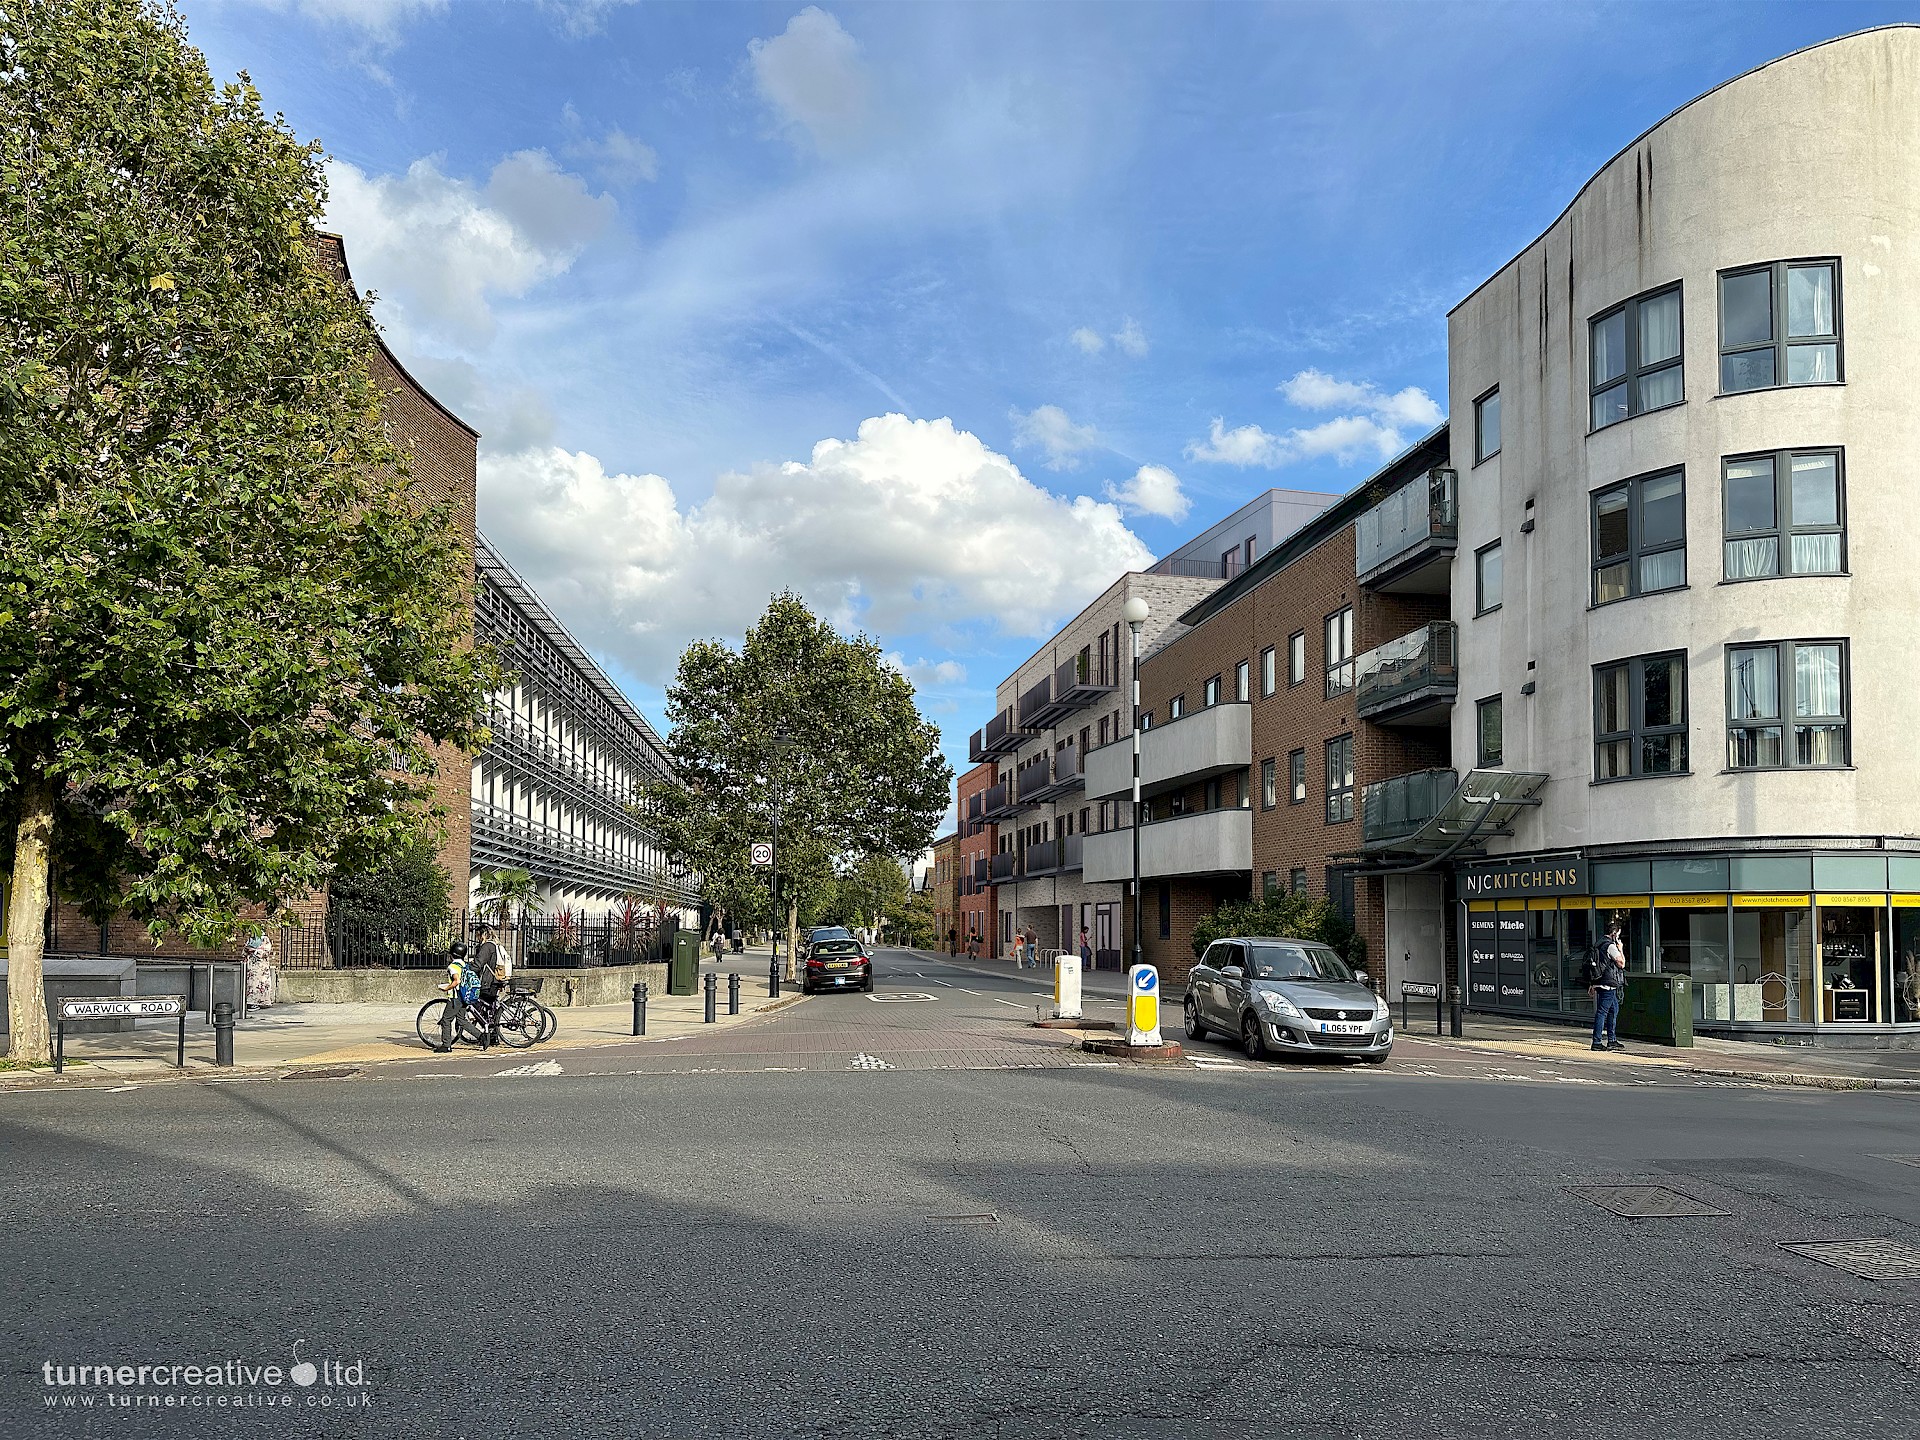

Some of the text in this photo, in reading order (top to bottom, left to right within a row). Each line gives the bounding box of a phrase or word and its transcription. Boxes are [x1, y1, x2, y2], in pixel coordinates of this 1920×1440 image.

[755, 850, 769, 858] 20
[1471, 921, 1494, 929] SIEMENS
[1500, 921, 1525, 930] Miele
[1479, 984, 1495, 992] BOSCH
[74, 1003, 173, 1014] WARWICK ROAD
[1326, 1024, 1364, 1034] LO65 YPF
